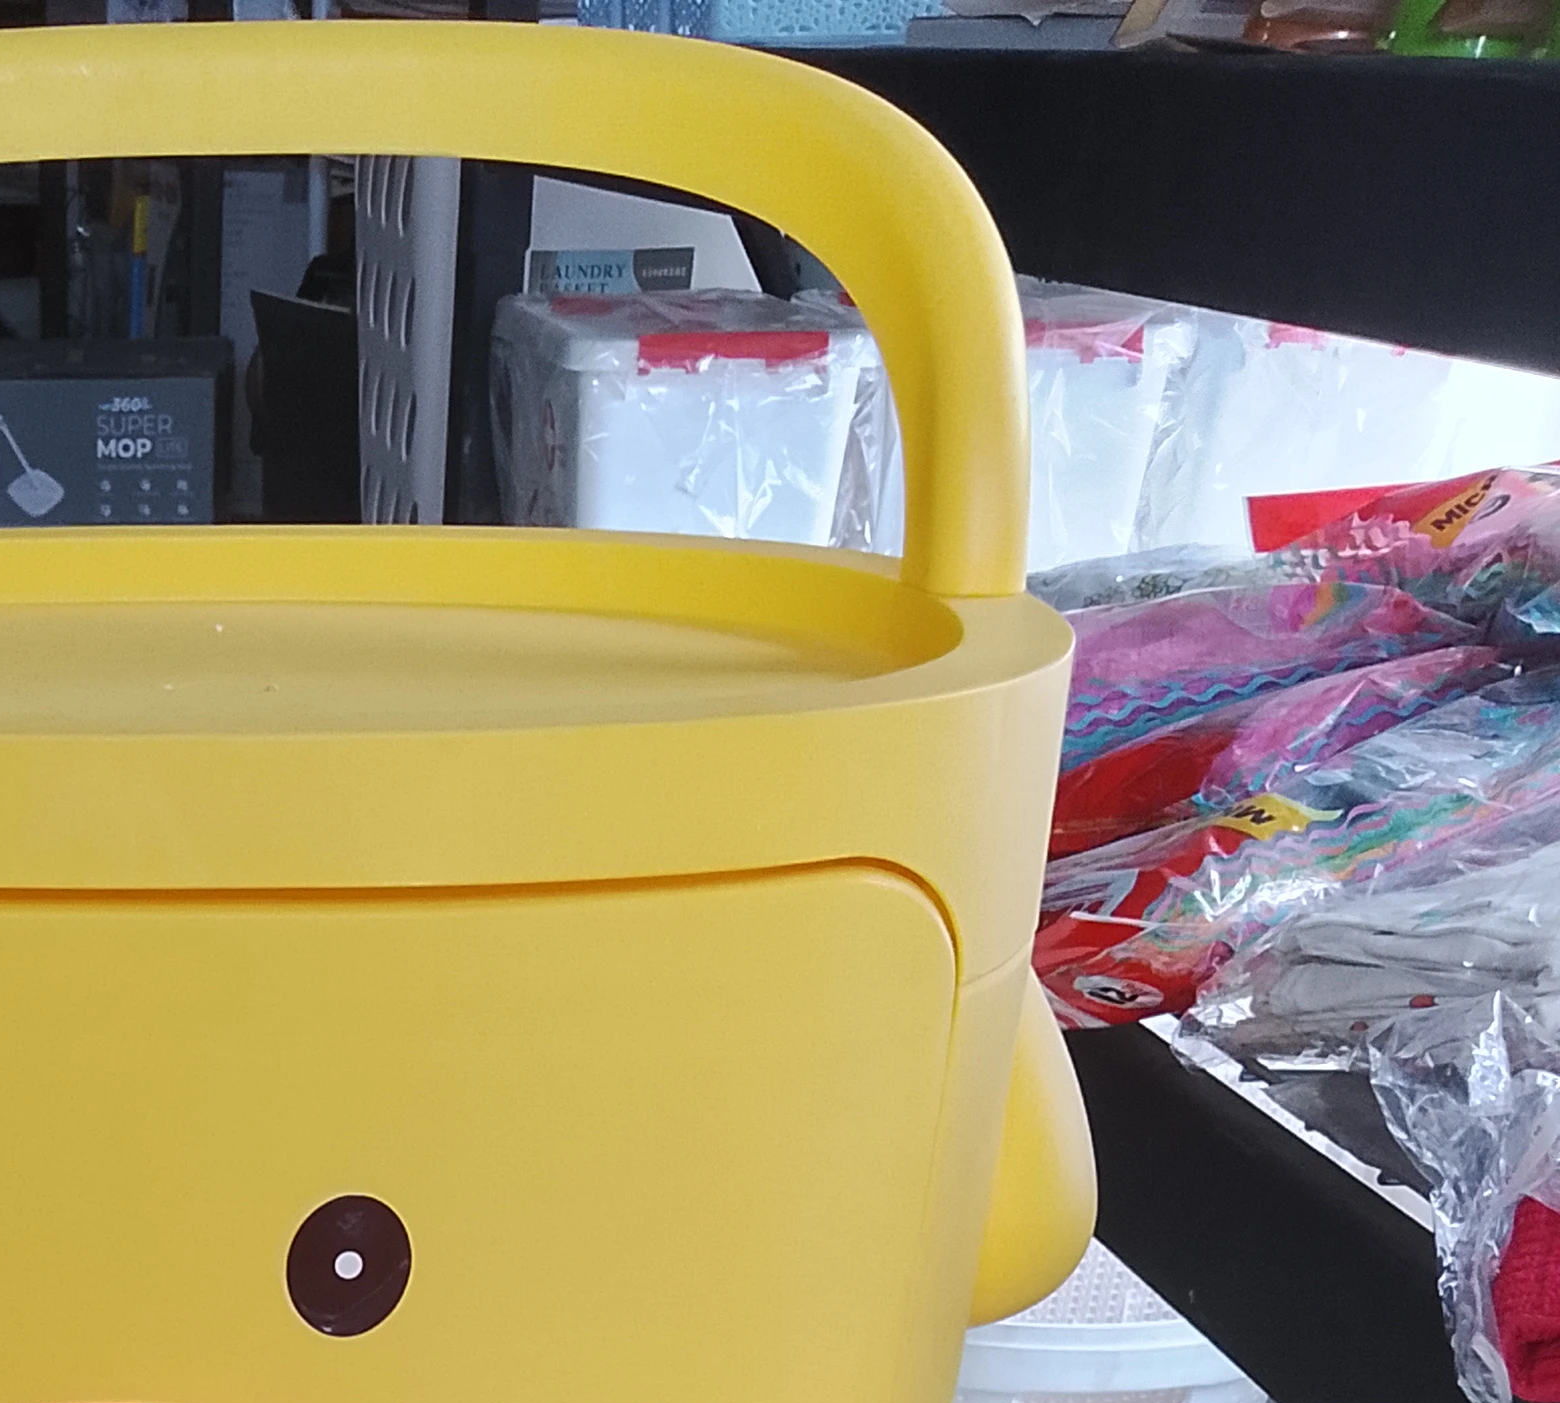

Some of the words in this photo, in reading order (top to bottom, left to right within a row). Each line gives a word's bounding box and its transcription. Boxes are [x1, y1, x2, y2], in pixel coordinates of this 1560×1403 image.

[540, 264, 627, 279] LAUNDRY
[97, 414, 174, 436] SUPER
[96, 438, 153, 459] MOP
